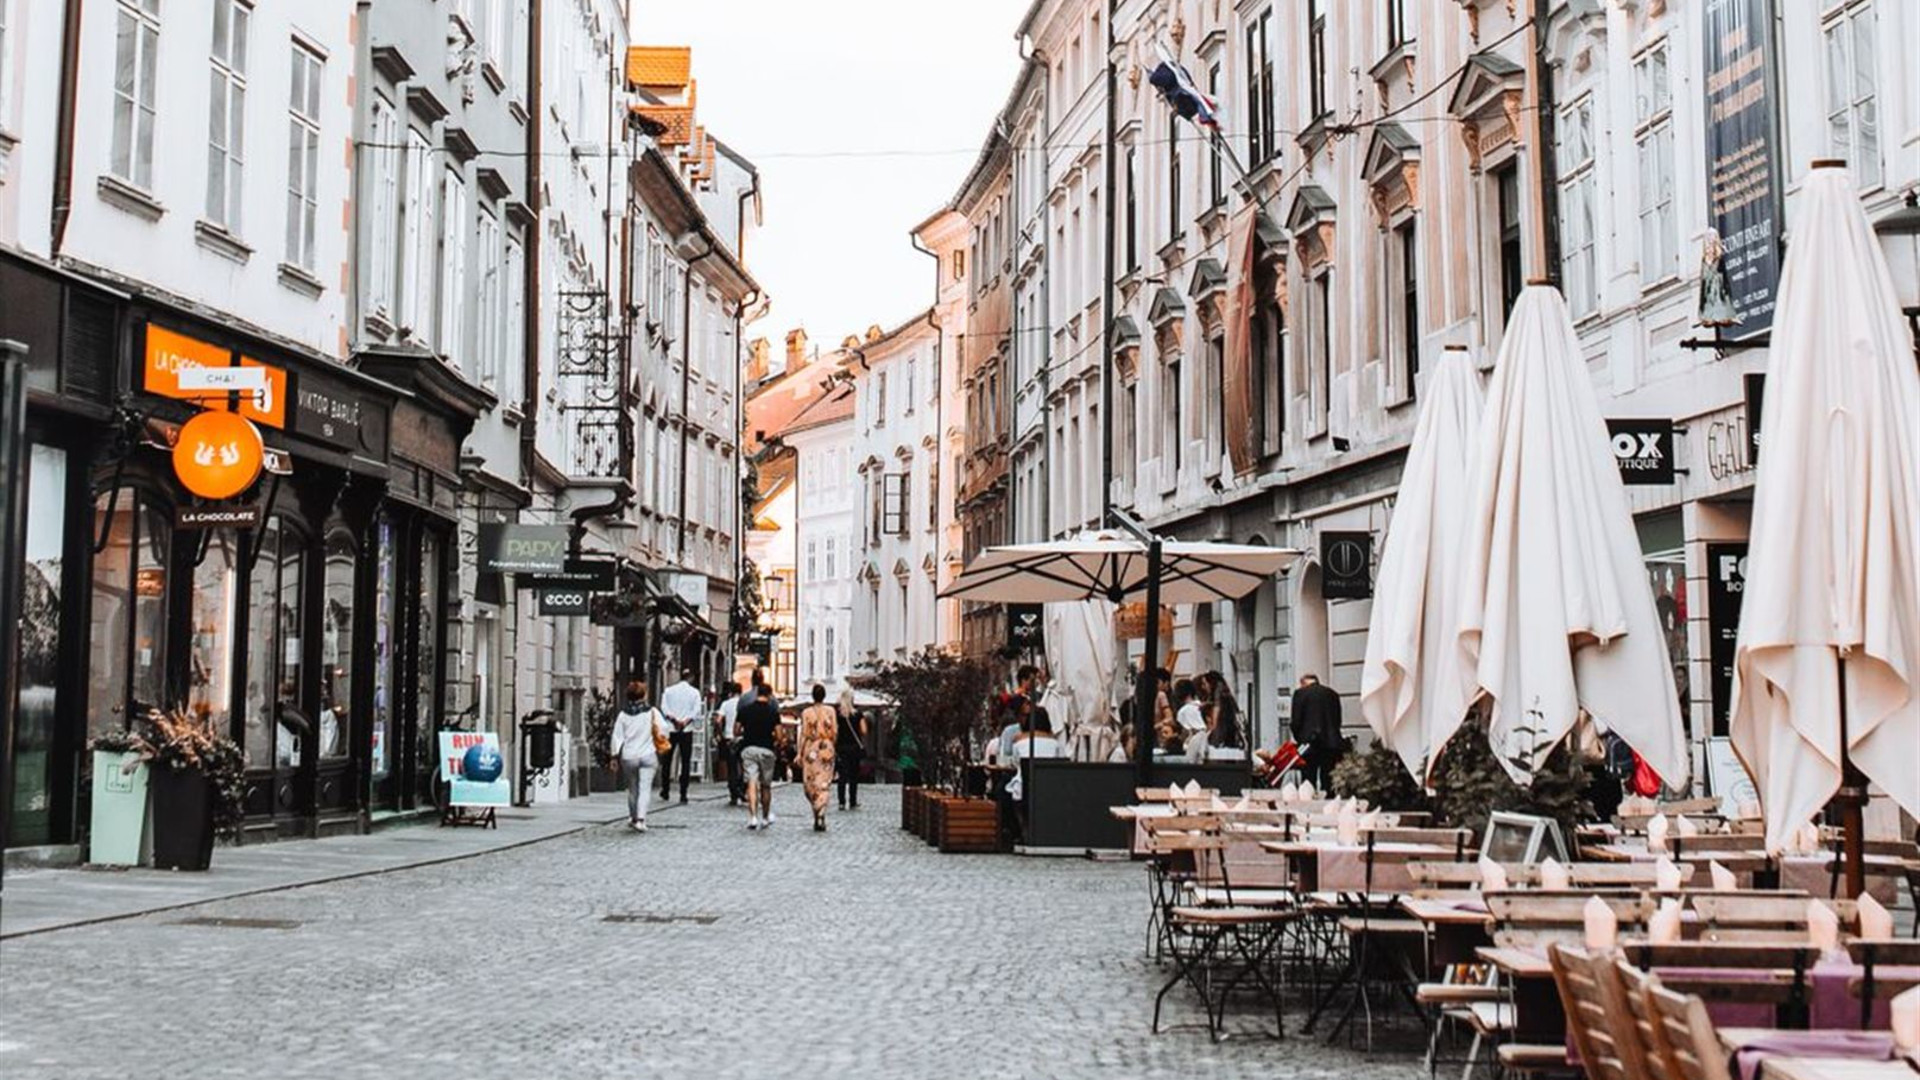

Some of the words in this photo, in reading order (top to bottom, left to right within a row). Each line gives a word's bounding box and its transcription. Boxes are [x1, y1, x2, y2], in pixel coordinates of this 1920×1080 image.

[182, 513, 196, 522] LA
[197, 511, 255, 521] CHOCOLATE
[507, 540, 560, 557] PAPY
[545, 594, 582, 606] ecco
